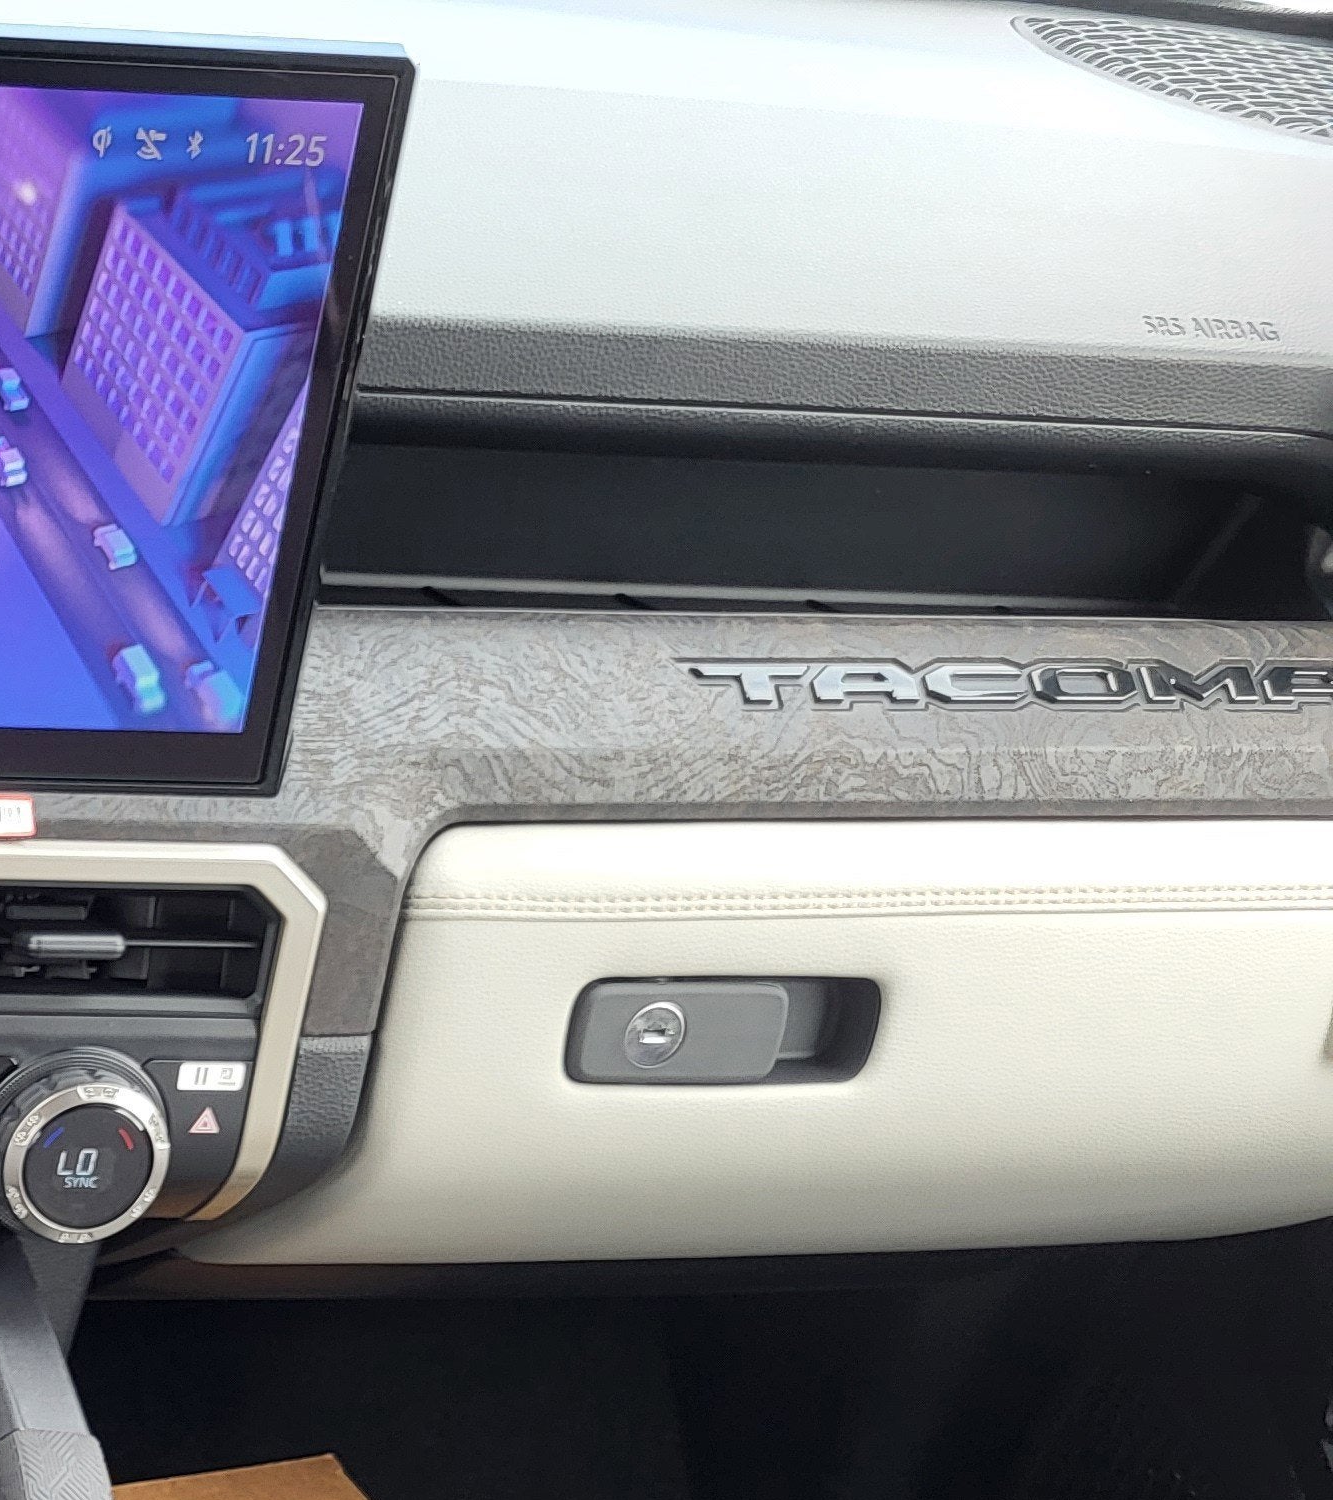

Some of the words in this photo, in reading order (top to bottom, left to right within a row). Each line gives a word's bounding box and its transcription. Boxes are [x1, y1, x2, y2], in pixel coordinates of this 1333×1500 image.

[246, 132, 326, 166] 11:25
[1142, 315, 1186, 336] SRS
[1191, 317, 1281, 341] AIRBAG
[62, 1176, 99, 1189] SYNC
